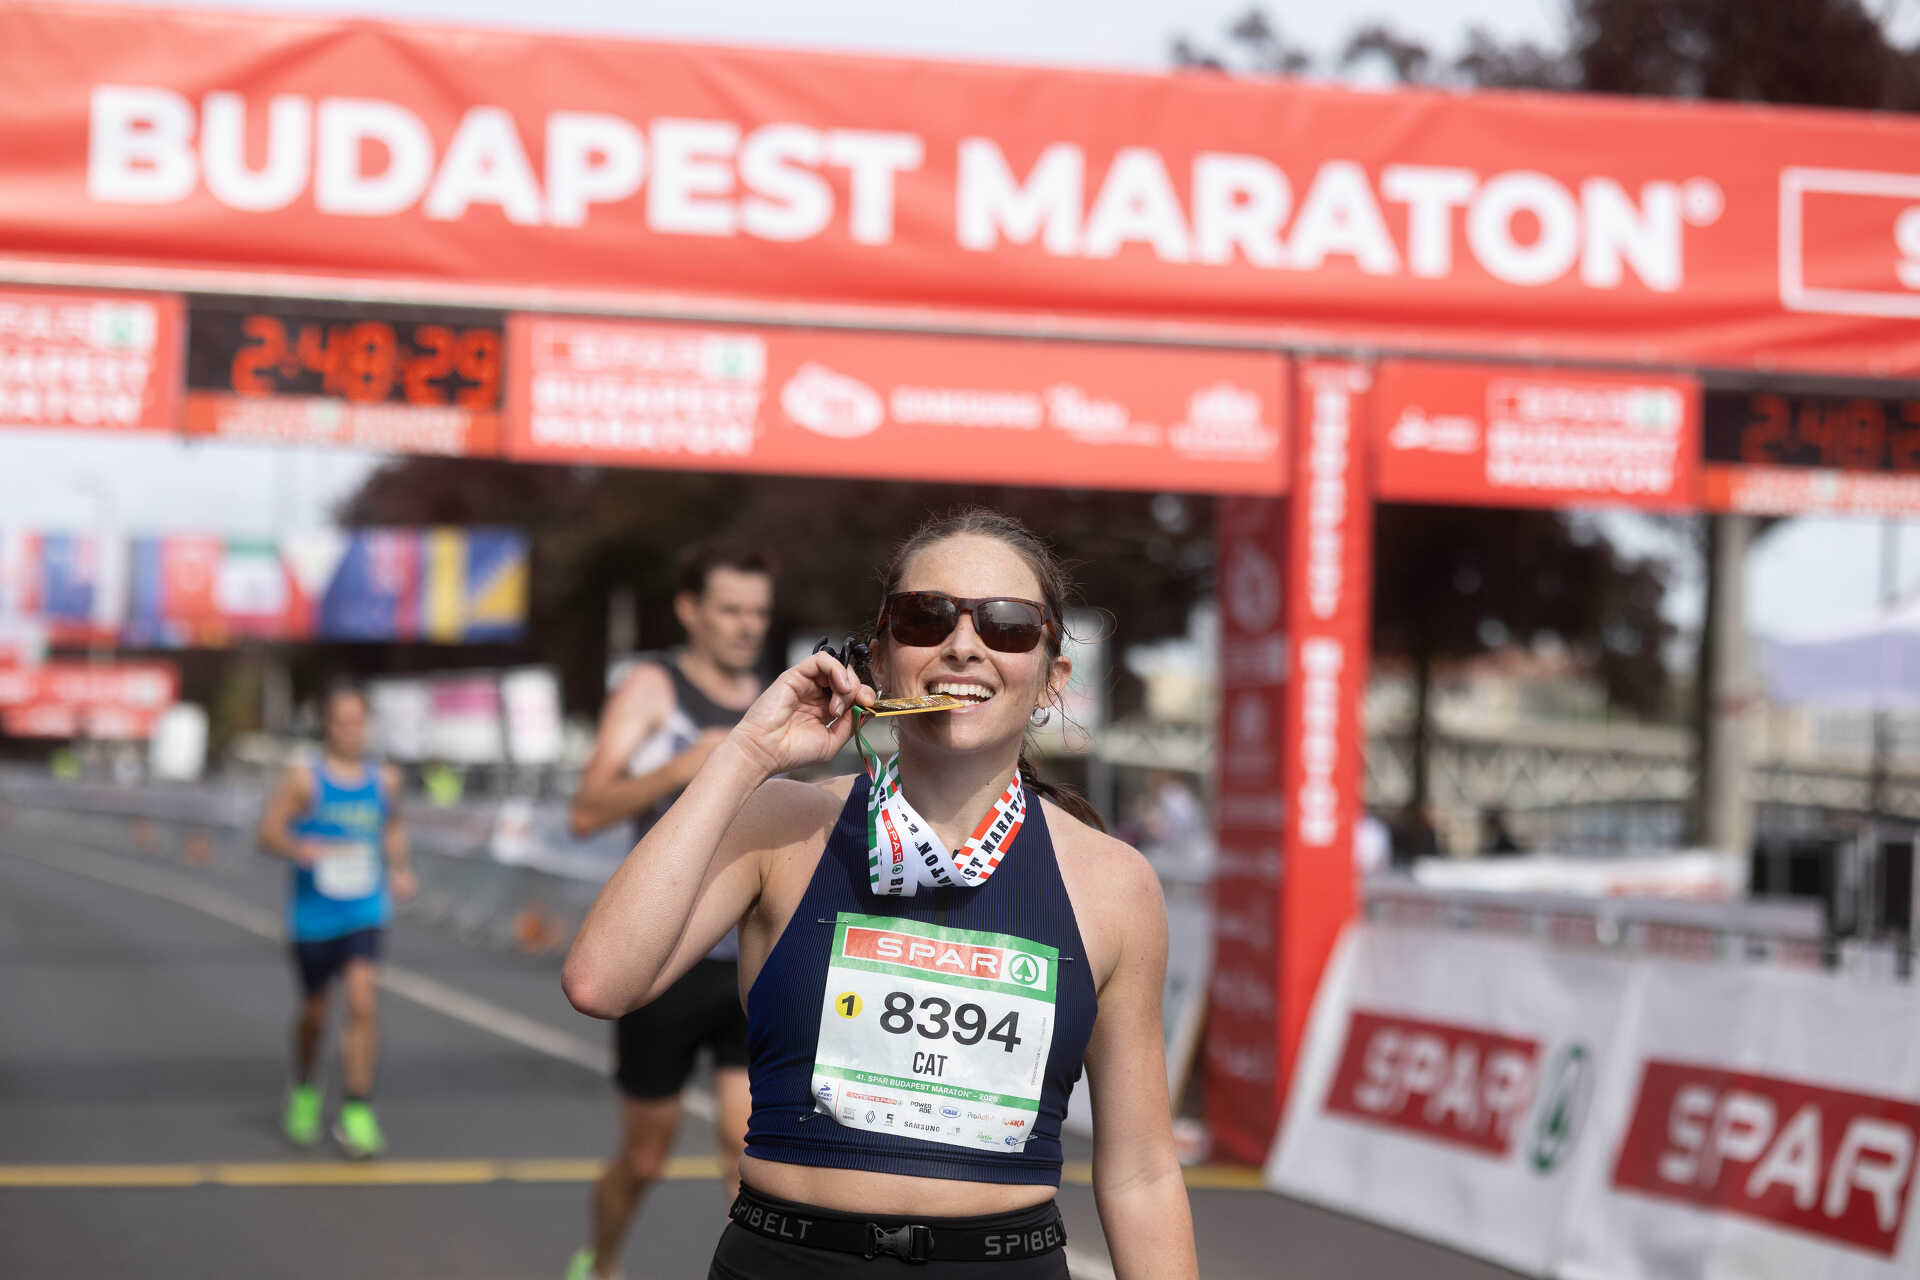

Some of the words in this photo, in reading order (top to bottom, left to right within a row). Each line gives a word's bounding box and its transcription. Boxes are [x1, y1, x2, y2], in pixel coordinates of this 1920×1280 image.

[86, 84, 923, 246] BUDAPEST
[884, 820, 903, 865] SPAR
[961, 857, 983, 880] ST
[981, 785, 1024, 855] MARATO
[876, 937, 999, 974] SPAR
[841, 994, 856, 1016] 1
[879, 991, 1022, 1053] 8394
[868, 1076, 889, 1085] SPAR
[889, 1079, 930, 1091] BUDAPEST
[912, 1051, 948, 1077] CAT
[1353, 1026, 1530, 1147] SPAR
[904, 1121, 941, 1132] SAMSUNG
[1657, 1083, 1916, 1232] SPAR
[984, 1224, 1064, 1256] SPIBEL
